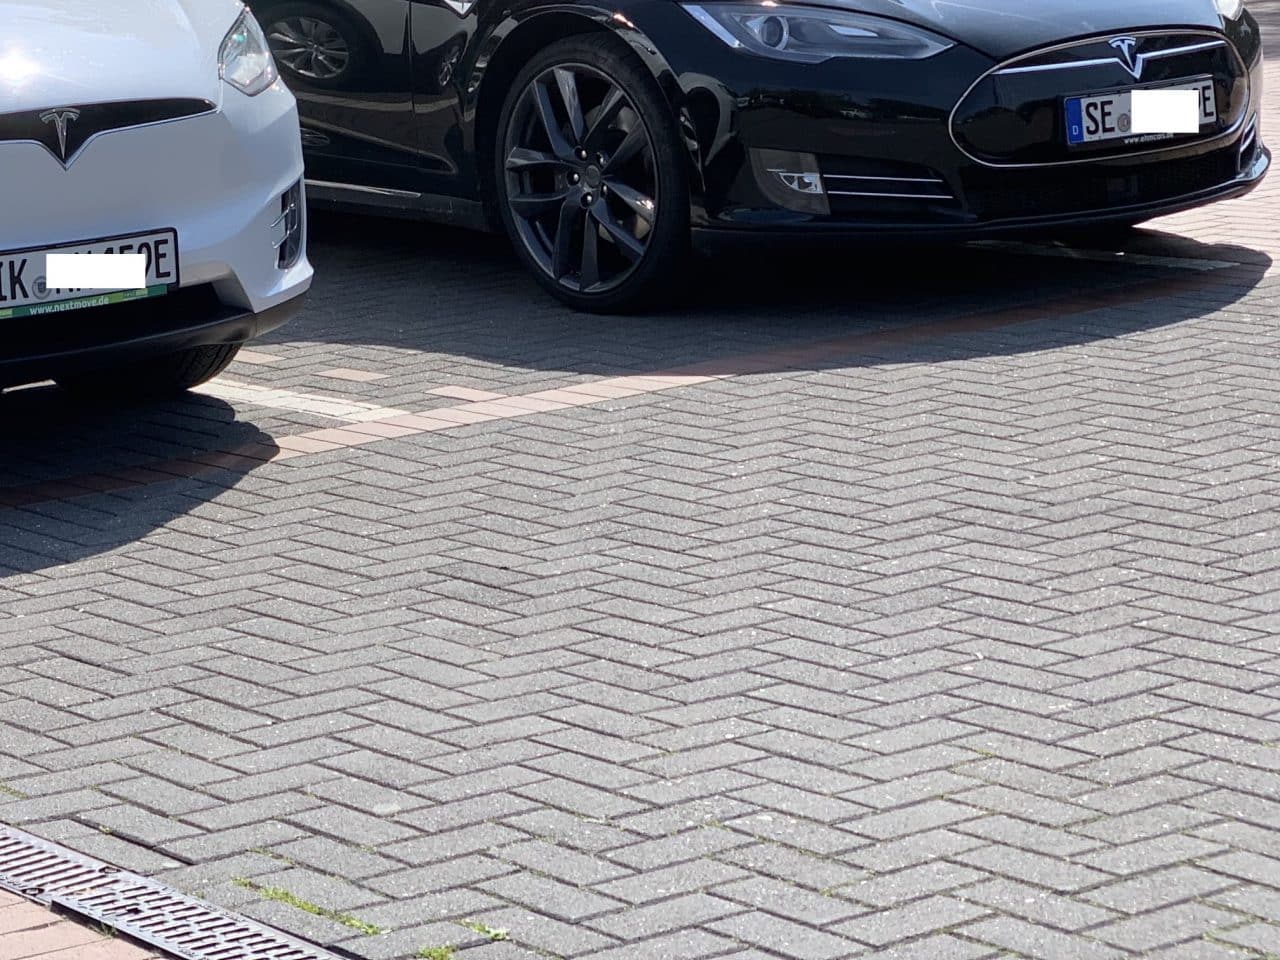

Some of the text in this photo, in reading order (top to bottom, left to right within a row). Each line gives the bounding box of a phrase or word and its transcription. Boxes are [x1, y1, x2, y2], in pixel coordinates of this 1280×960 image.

[1085, 100, 1115, 136] SE
[1072, 124, 1079, 135] D
[29, 294, 110, 316] www.nextmove.de
